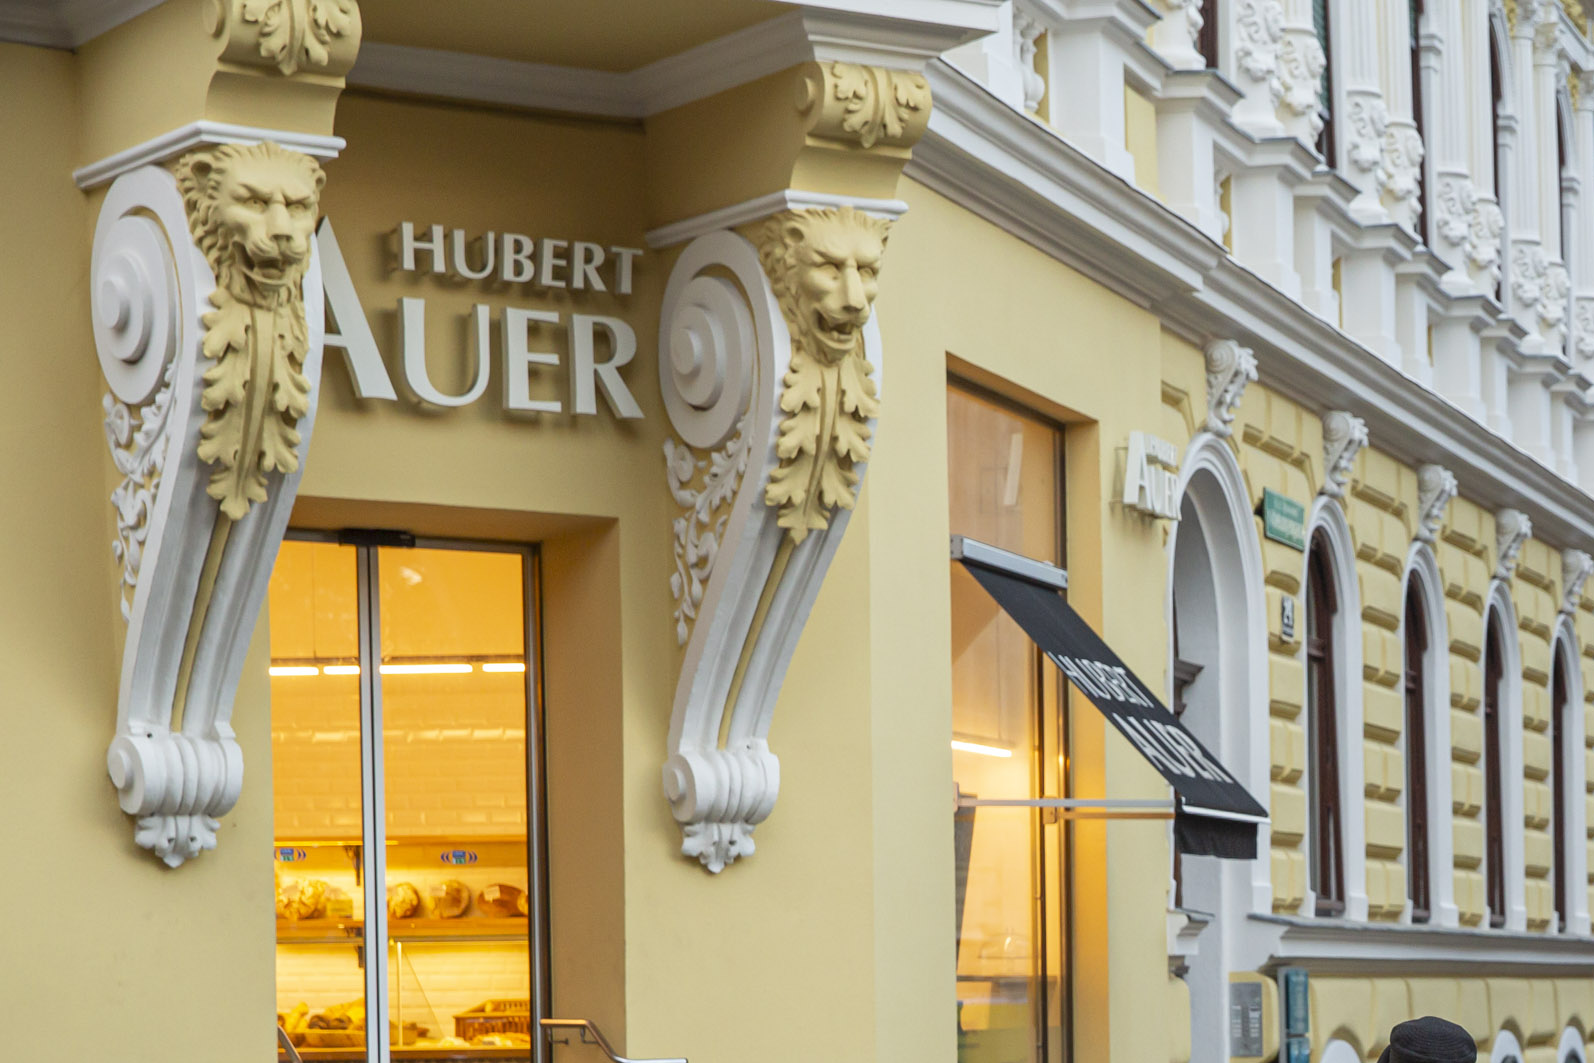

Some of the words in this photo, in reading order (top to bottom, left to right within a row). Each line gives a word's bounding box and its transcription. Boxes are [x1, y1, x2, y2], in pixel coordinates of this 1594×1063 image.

[401, 221, 644, 294] HUBERT
[317, 215, 645, 419] AUER
[1113, 712, 1234, 784] AUER
